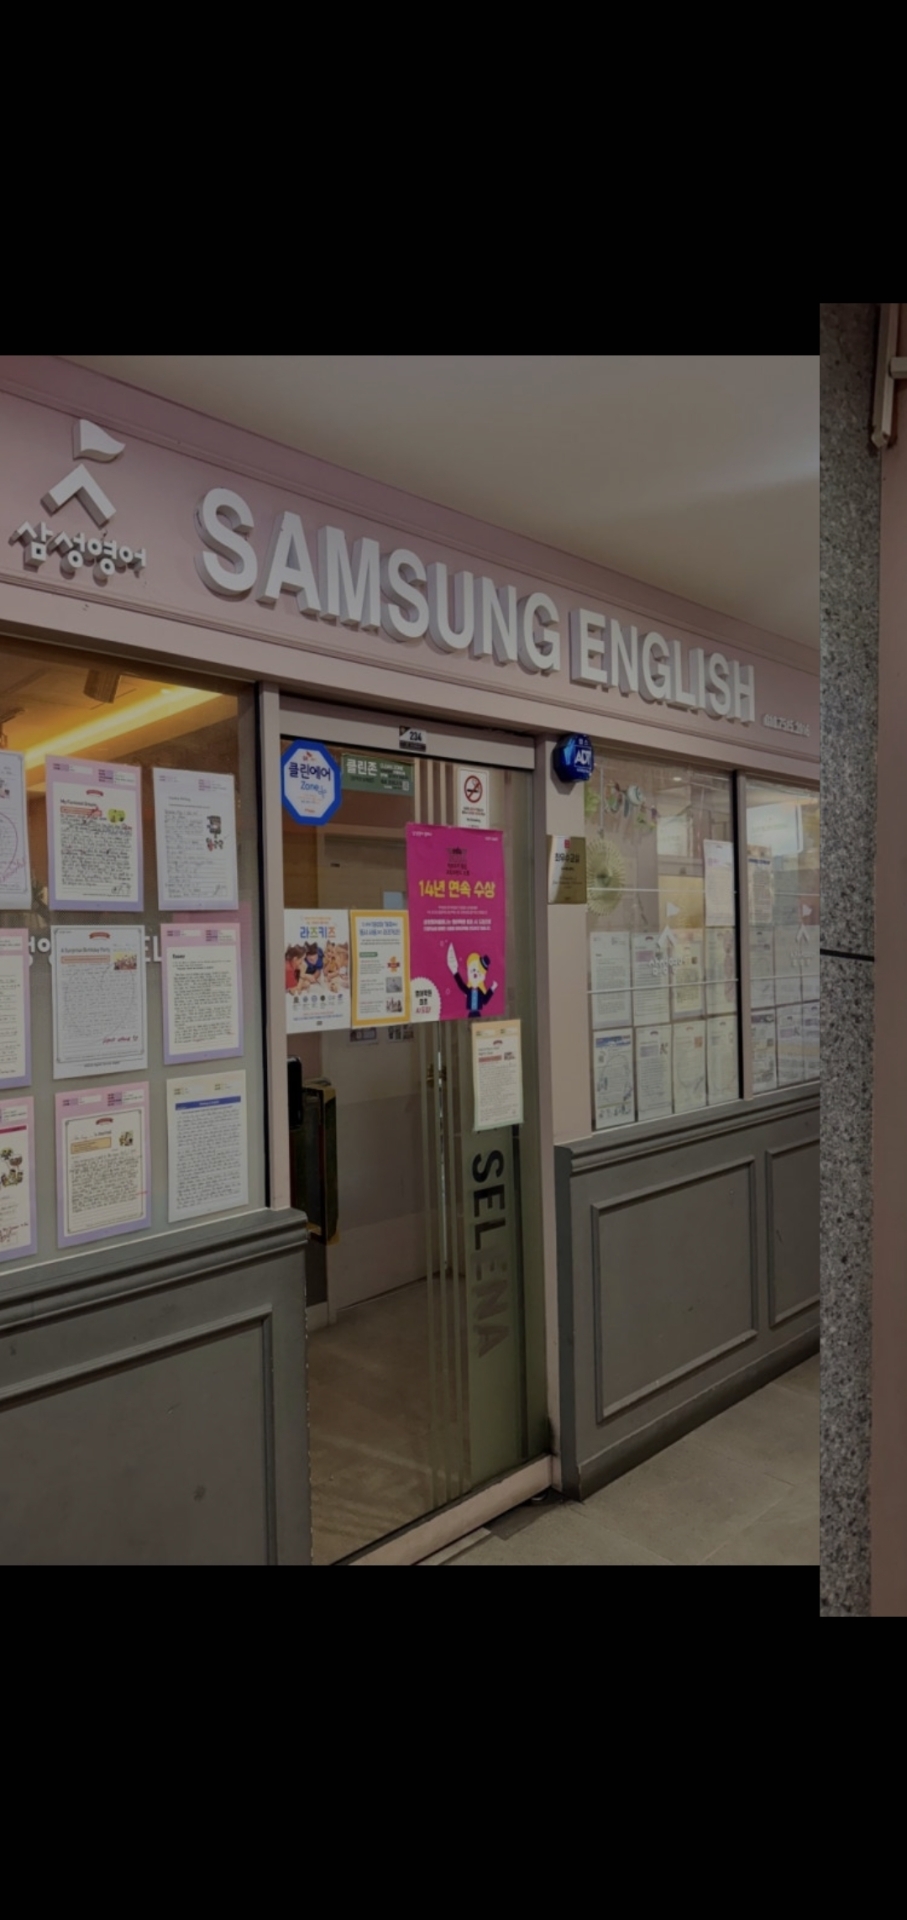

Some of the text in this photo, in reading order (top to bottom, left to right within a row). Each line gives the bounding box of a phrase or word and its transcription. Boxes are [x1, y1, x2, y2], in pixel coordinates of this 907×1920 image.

[12, 520, 147, 579] 삼성영어
[197, 487, 756, 723] SAMSUNG ENGLISH
[409, 731, 422, 741] 234
[574, 749, 591, 765] ADT
[289, 761, 331, 781] 클린에어
[346, 758, 378, 776] 클린존
[418, 879, 496, 898] 14년 연속 수상
[300, 926, 336, 939] 라즈키즈
[471, 1150, 510, 1358] SELENA
